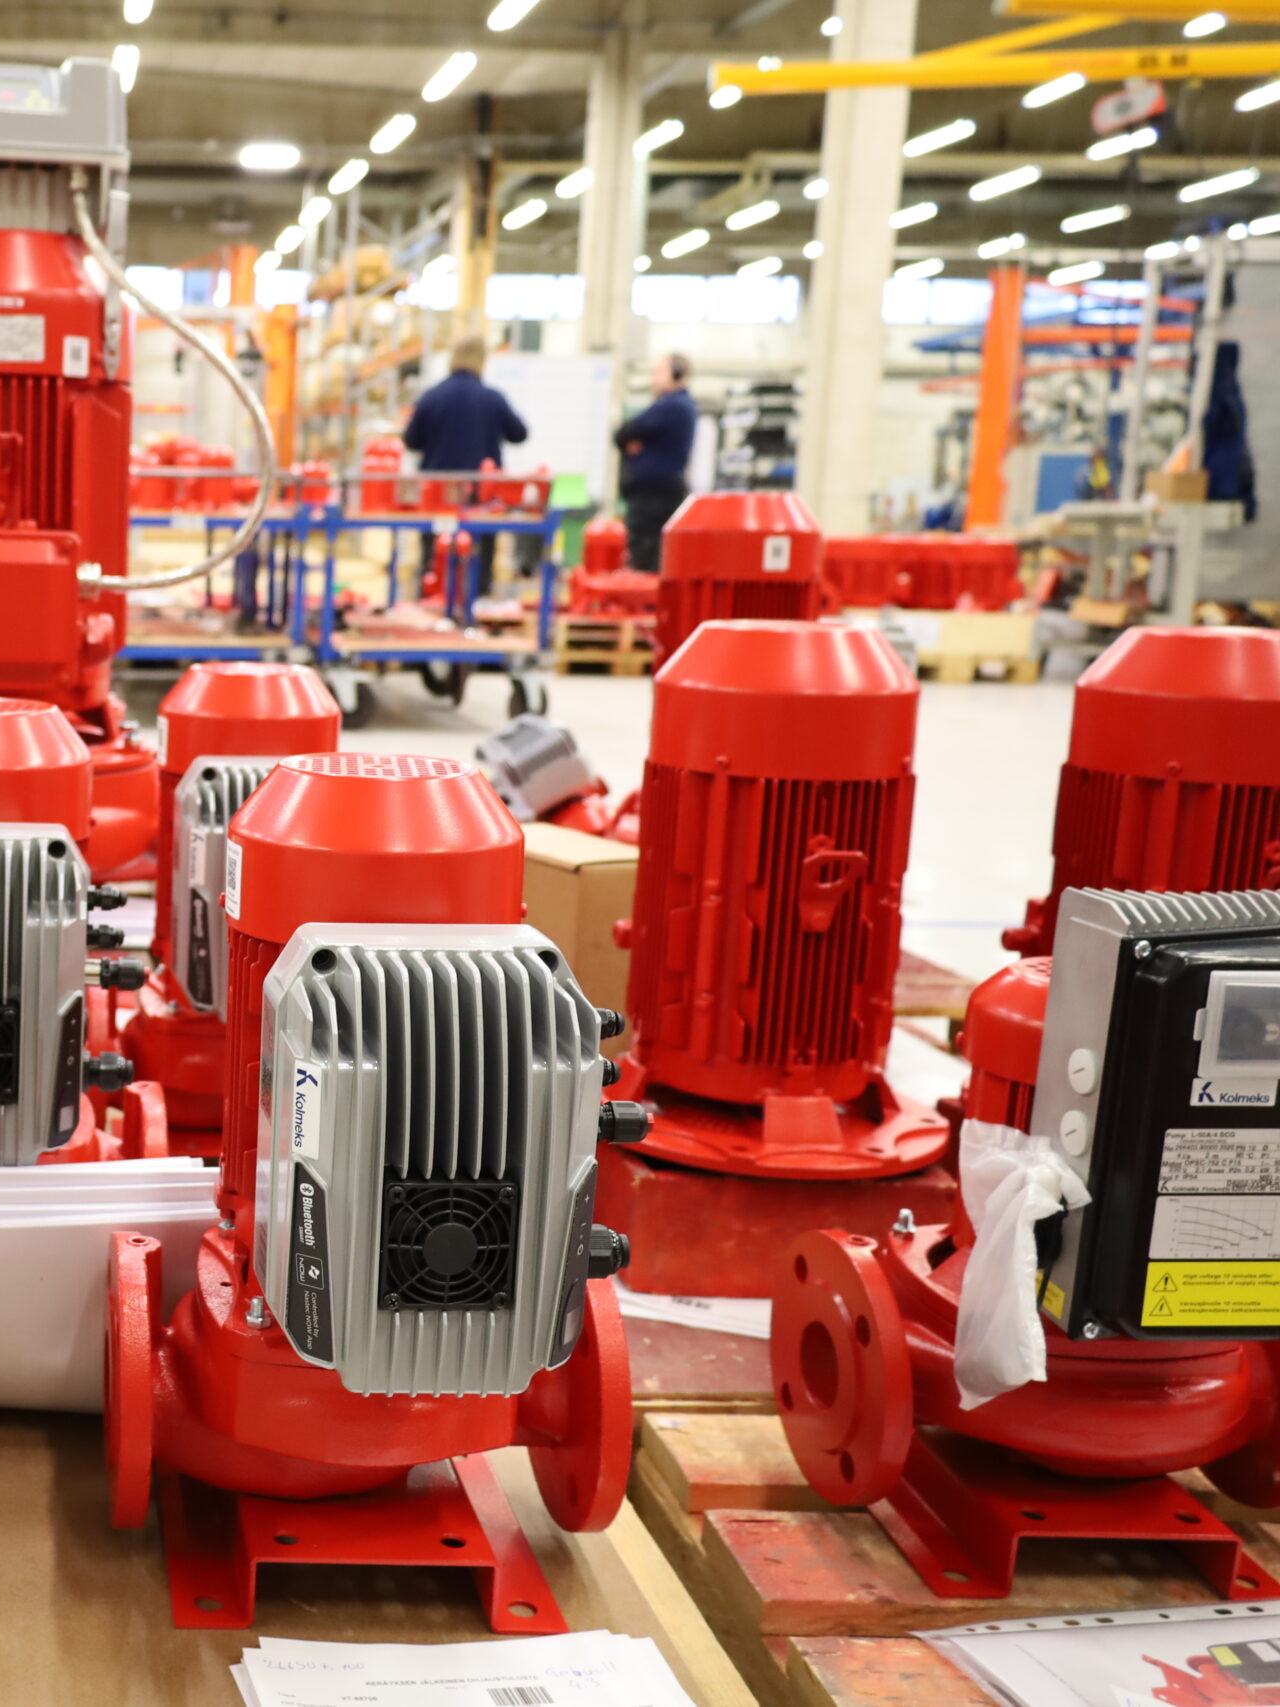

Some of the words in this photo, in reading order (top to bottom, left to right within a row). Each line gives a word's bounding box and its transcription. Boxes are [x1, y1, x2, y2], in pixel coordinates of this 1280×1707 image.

[294, 1091, 306, 1149] Kolmeks
[1219, 1092, 1270, 1103] Kolmeks
[302, 1197, 315, 1246] Bluetooth
